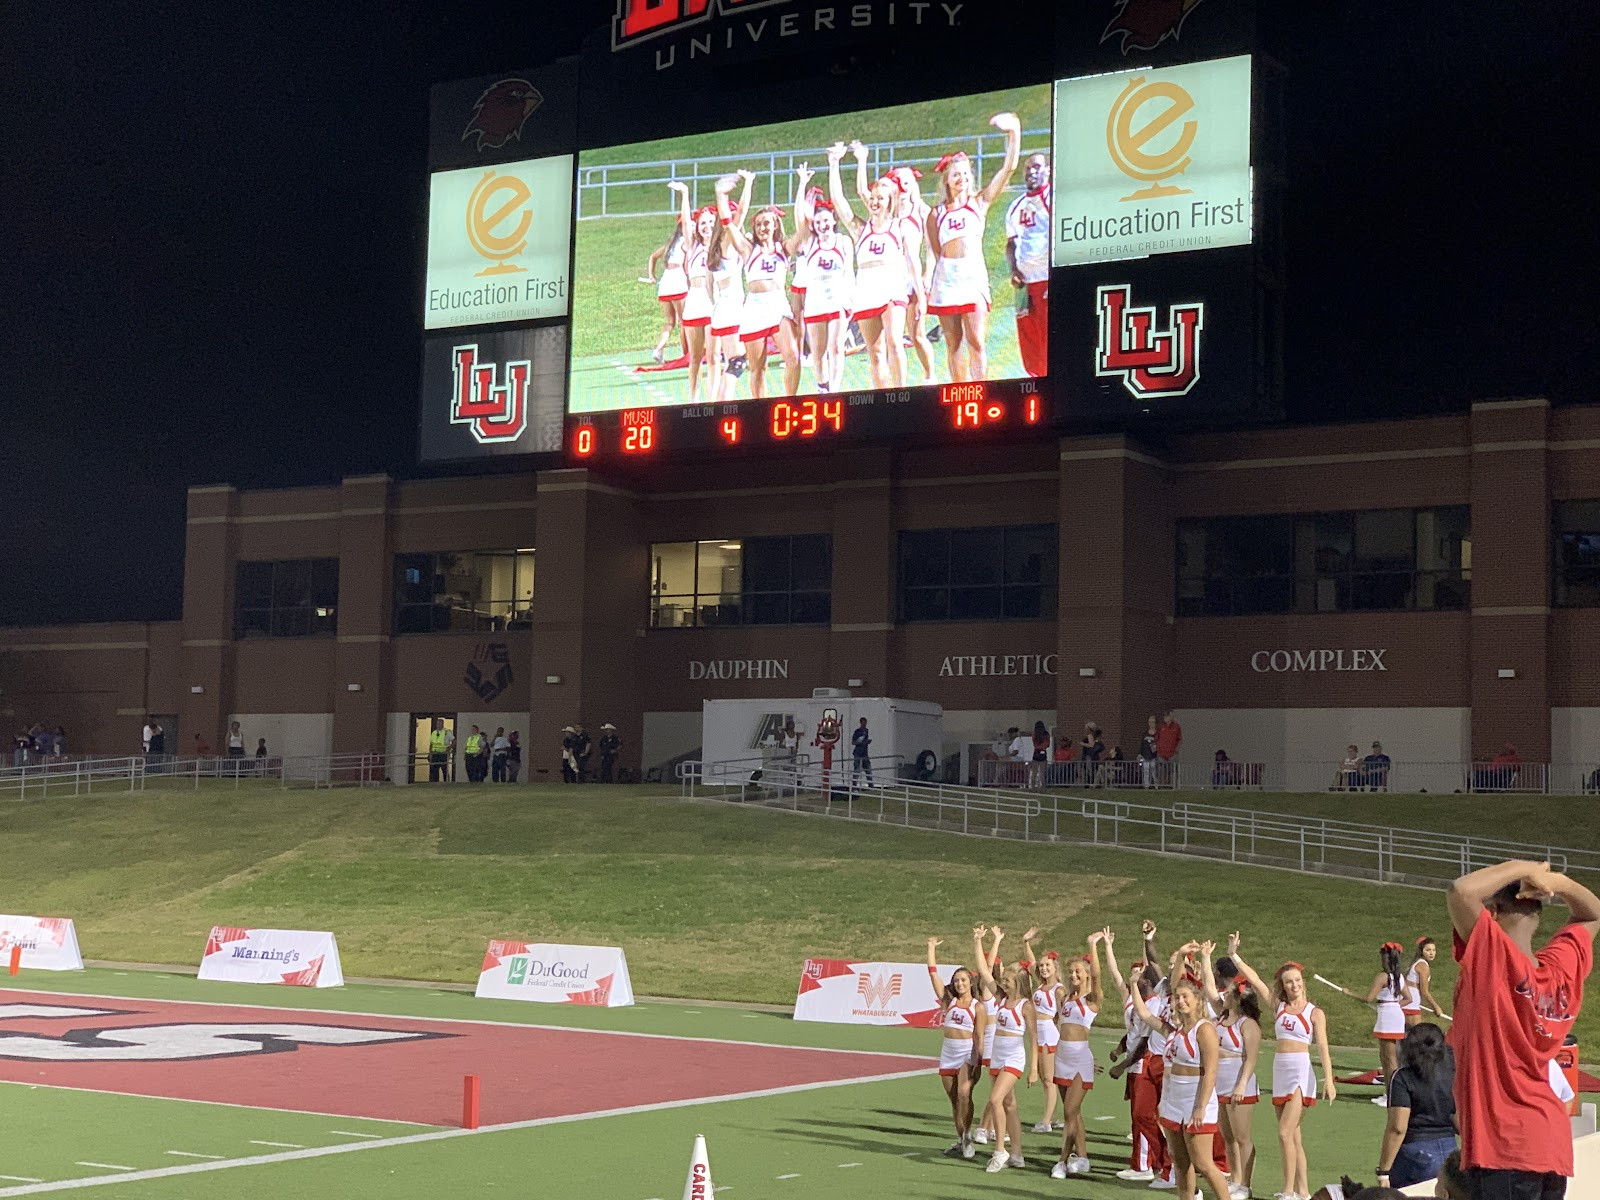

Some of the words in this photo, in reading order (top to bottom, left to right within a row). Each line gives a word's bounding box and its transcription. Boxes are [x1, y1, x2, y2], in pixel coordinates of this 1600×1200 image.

[655, 2, 964, 71] UNIVERSITY
[1060, 208, 1180, 243] Education
[1191, 198, 1244, 228] First
[1089, 243, 1134, 256] FEDERAL
[1138, 239, 1175, 251] CREDIT
[1179, 236, 1212, 247] UNION
[430, 283, 518, 311] Education
[525, 275, 565, 301] First
[450, 313, 483, 324] FEDERAL
[486, 309, 514, 320] CREDIT
[517, 308, 541, 317] UNION
[1095, 283, 1204, 399] LU
[449, 343, 532, 443] LU
[885, 392, 896, 403] TO
[898, 391, 910, 403] GO
[942, 385, 983, 403] LAMAR
[1020, 383, 1038, 394] TOL
[849, 394, 874, 406] DOWN
[1028, 399, 1036, 421] 1
[623, 410, 654, 426] MVSU
[682, 408, 701, 419] BALL
[703, 406, 714, 417] ON
[773, 401, 841, 437] 0:34
[956, 402, 979, 426] 19
[578, 430, 591, 453] 0
[625, 426, 652, 450] 20
[724, 420, 737, 442] 4
[689, 659, 790, 680] DAUPHIN
[938, 654, 1058, 677] ATHLETIC
[1250, 648, 1388, 673] COMPLEX
[231, 946, 300, 964] Manning's
[529, 960, 589, 979] DuGood
[527, 978, 548, 987] Federal
[548, 979, 566, 988] Credit
[566, 981, 585, 989] Union
[851, 1008, 898, 1018] WHATABURGER
